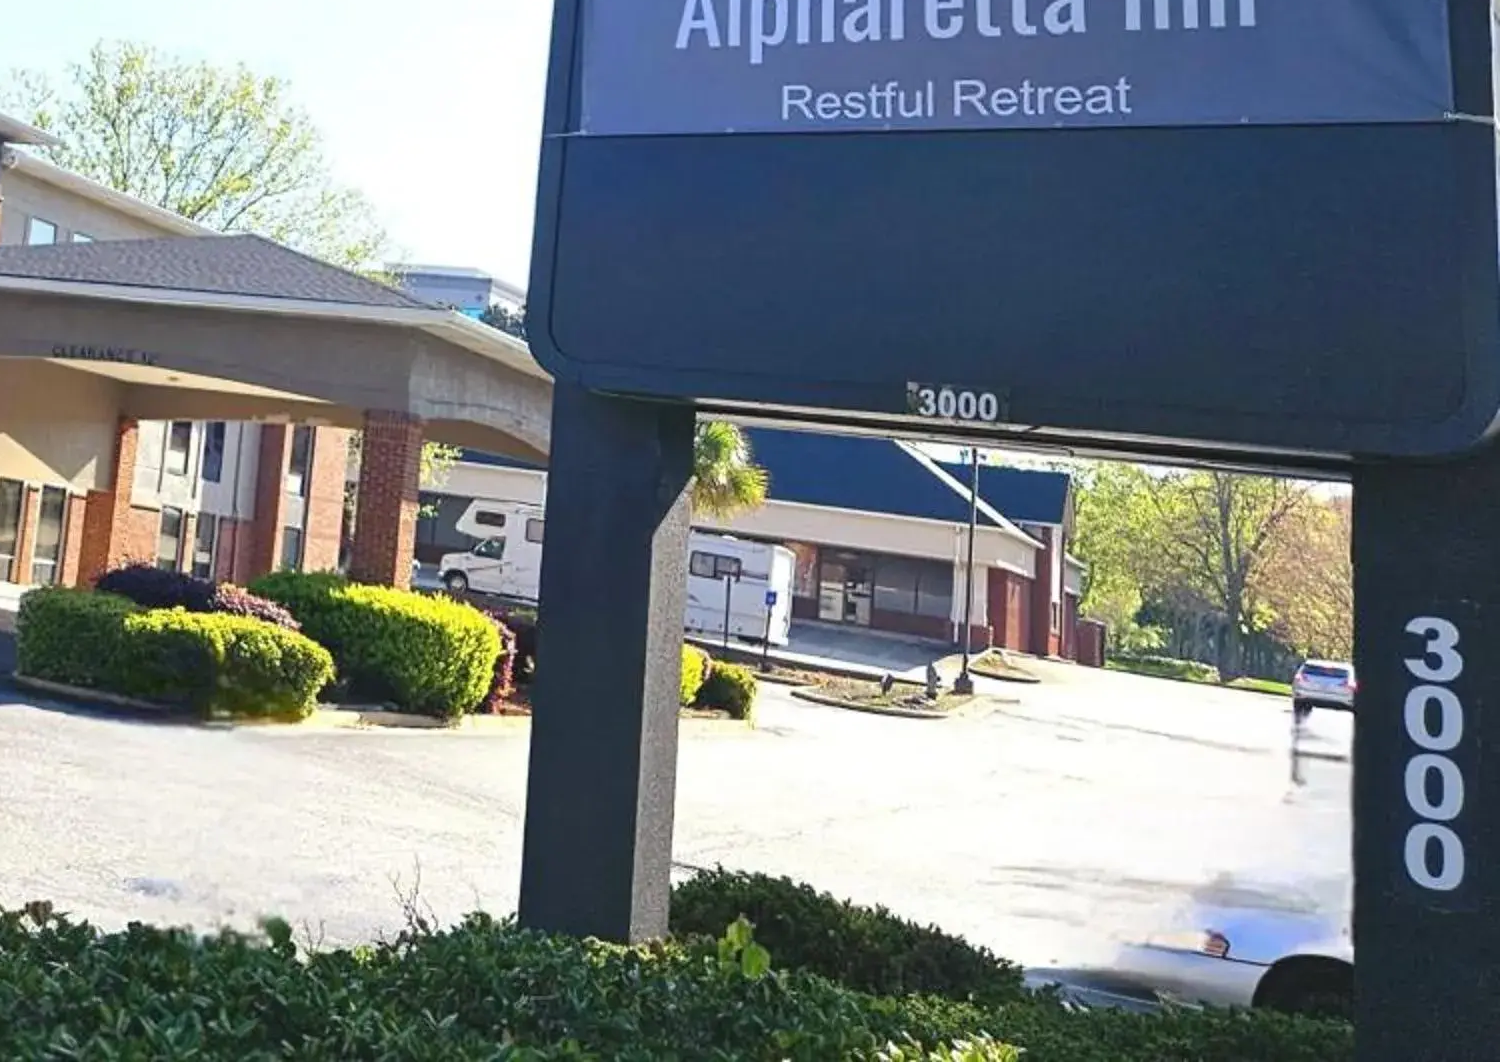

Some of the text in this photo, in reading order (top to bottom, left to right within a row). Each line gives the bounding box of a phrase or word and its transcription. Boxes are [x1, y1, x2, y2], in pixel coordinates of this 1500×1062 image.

[781, 76, 1132, 120] Restful Retreat
[917, 388, 998, 421] 3000
[1404, 616, 1465, 891] 3000
